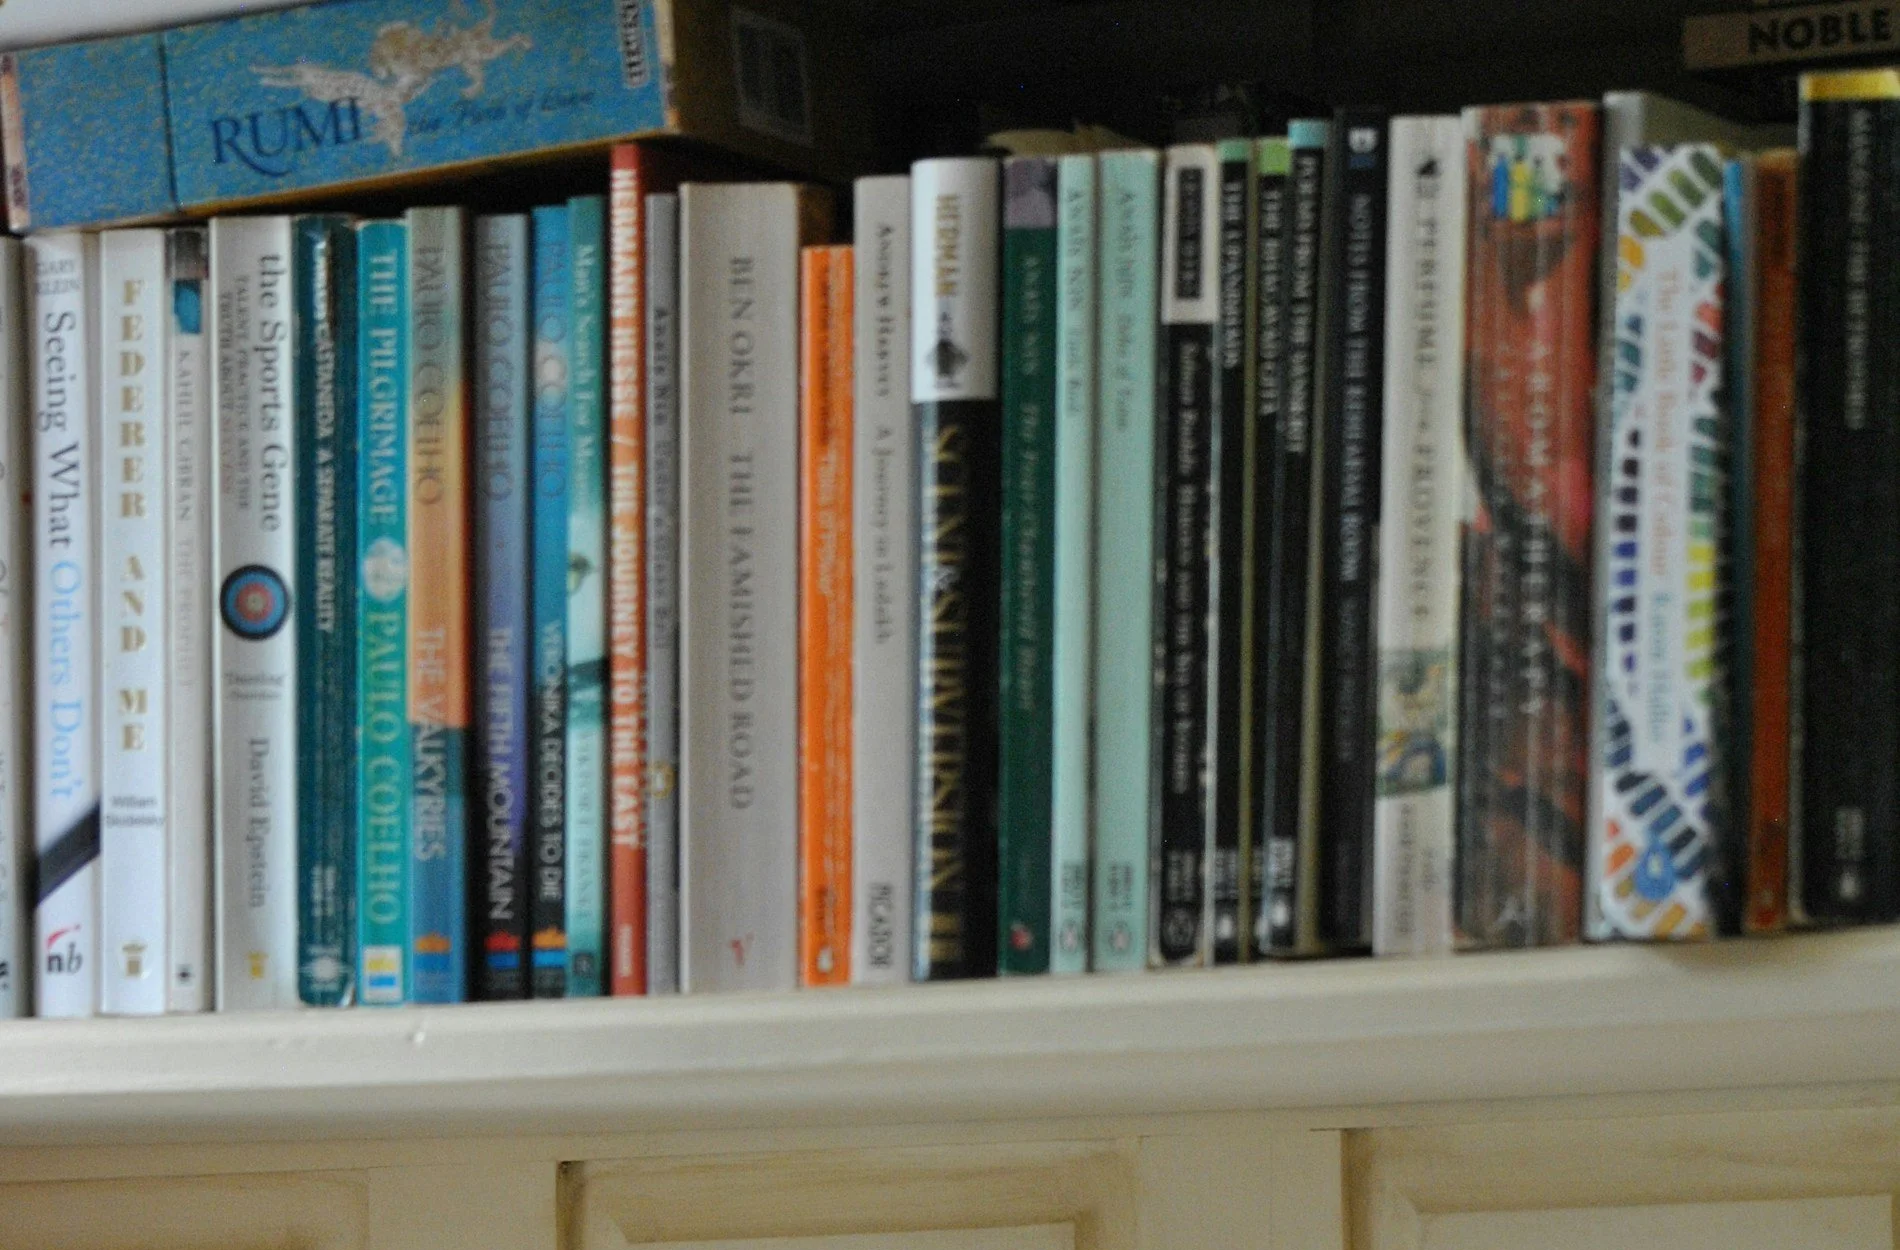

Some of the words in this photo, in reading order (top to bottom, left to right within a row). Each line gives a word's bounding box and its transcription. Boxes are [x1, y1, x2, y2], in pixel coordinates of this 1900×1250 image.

[1749, 8, 1892, 54] NOBLE
[212, 96, 362, 178] RUMI
[258, 254, 285, 310] the
[368, 250, 398, 317] THE
[575, 243, 596, 307] Man's
[611, 169, 638, 317] HERMANN
[875, 222, 896, 309] ANDREW
[935, 193, 962, 298] HERMAN
[415, 247, 445, 351] PAULO
[485, 242, 513, 348] PAULO
[539, 242, 567, 344] PAULO
[728, 256, 755, 320] BEN
[1064, 267, 1085, 313] NIN
[1415, 218, 1440, 366] PERFUME
[1656, 270, 1682, 312] The
[38, 311, 77, 432] Seeing
[177, 348, 194, 430] KAHLIL
[253, 321, 286, 433] Sports
[314, 321, 335, 440] CASTANEDA
[575, 313, 596, 385] Search
[611, 325, 638, 422] HESSE
[728, 330, 755, 416] OKRI
[875, 315, 896, 398] HARVEY
[1655, 320, 1681, 382] Little
[121, 280, 147, 518] FEDERER
[368, 327, 399, 525] PILGRIMAGE
[416, 361, 445, 506] COELHO
[485, 357, 515, 501] COELHO
[539, 354, 567, 498] COELHO
[875, 425, 896, 442] A
[1654, 391, 1679, 454] Book
[48, 442, 80, 549] What
[177, 440, 194, 521] GIBRAN
[236, 439, 251, 475] AND
[236, 476, 251, 510] THE
[260, 444, 288, 532] Gene
[315, 448, 334, 464] A
[611, 462, 638, 518] THE
[728, 455, 755, 514] THE
[870, 446, 896, 530] Journey
[920, 423, 968, 561] SCENT
[1653, 460, 1676, 489] of
[315, 466, 335, 557] SEPARATE
[875, 536, 894, 559] in
[1410, 443, 1437, 620] PROVENCE
[1520, 340, 1550, 716] AROMATHERAPY
[1652, 493, 1674, 577] Colour
[49, 560, 83, 686] Others
[121, 556, 147, 652] AND
[315, 559, 334, 634] REALITY
[611, 522, 638, 657] JOURNEY
[728, 525, 755, 703] FAMISHED
[366, 611, 402, 744] PAULO
[415, 627, 446, 687] THE
[488, 626, 513, 678] THE
[541, 620, 563, 736] VERONIKA
[611, 663, 638, 705] TO
[49, 700, 84, 801] Don't
[121, 690, 147, 750] ME
[488, 682, 514, 753] FIFTH
[611, 714, 638, 767] THE
[728, 710, 755, 810] ROAD
[917, 592, 966, 892] SUBVERSION
[248, 738, 269, 809] David
[414, 694, 446, 862] VALKYRIES
[539, 738, 562, 828] DECIDES
[611, 774, 638, 849] EAST
[246, 816, 270, 908] Epstein
[366, 756, 402, 925] COELHO
[486, 762, 515, 920] MOUNTAIN
[539, 833, 561, 864] TO
[539, 867, 561, 901] DIE
[47, 943, 82, 974] nb
